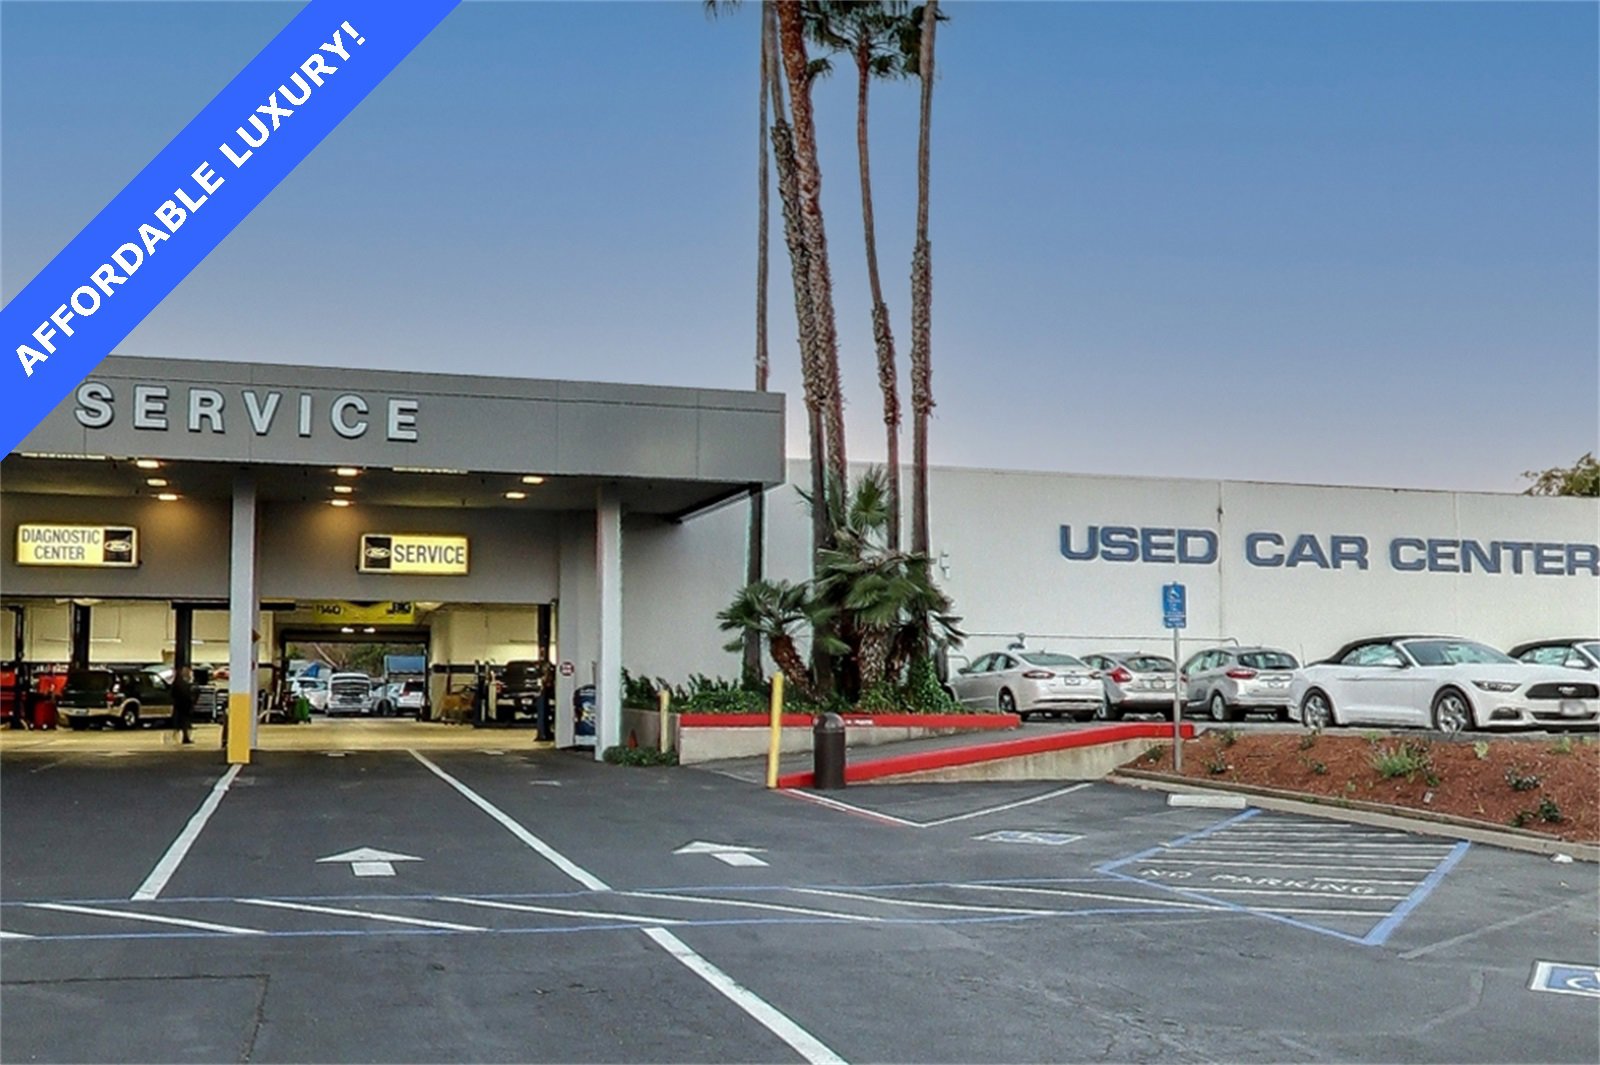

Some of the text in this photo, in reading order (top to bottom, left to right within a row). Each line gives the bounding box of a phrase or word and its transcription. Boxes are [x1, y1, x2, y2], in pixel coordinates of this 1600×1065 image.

[75, 382, 420, 442] SERVICE
[21, 528, 101, 545] DIAGNOSTIC
[34, 545, 86, 561] CENTER
[393, 544, 465, 565] SERVICE
[1059, 525, 1600, 577] USED CAR CENTER
[1139, 867, 1375, 895] NO PARKING
